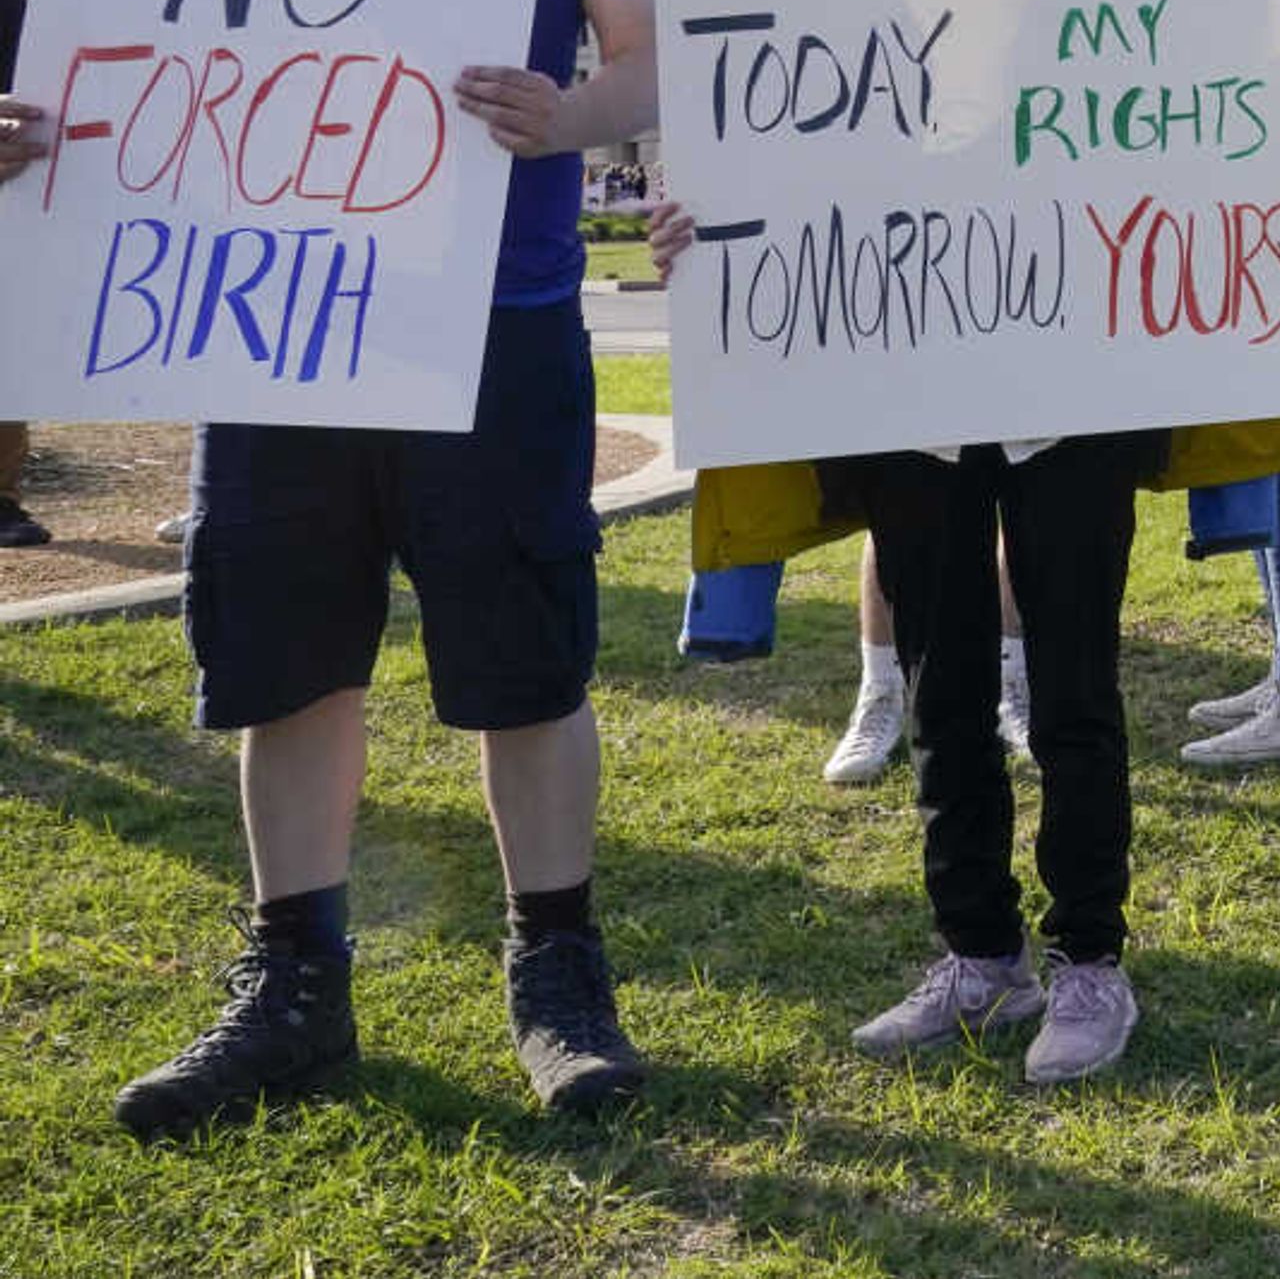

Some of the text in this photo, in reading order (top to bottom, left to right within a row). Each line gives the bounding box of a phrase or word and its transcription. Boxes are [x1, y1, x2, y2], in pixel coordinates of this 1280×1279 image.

[42, 44, 447, 214] FORCED
[1013, 76, 1269, 168] RIGHTS
[85, 217, 379, 383] BIRTH
